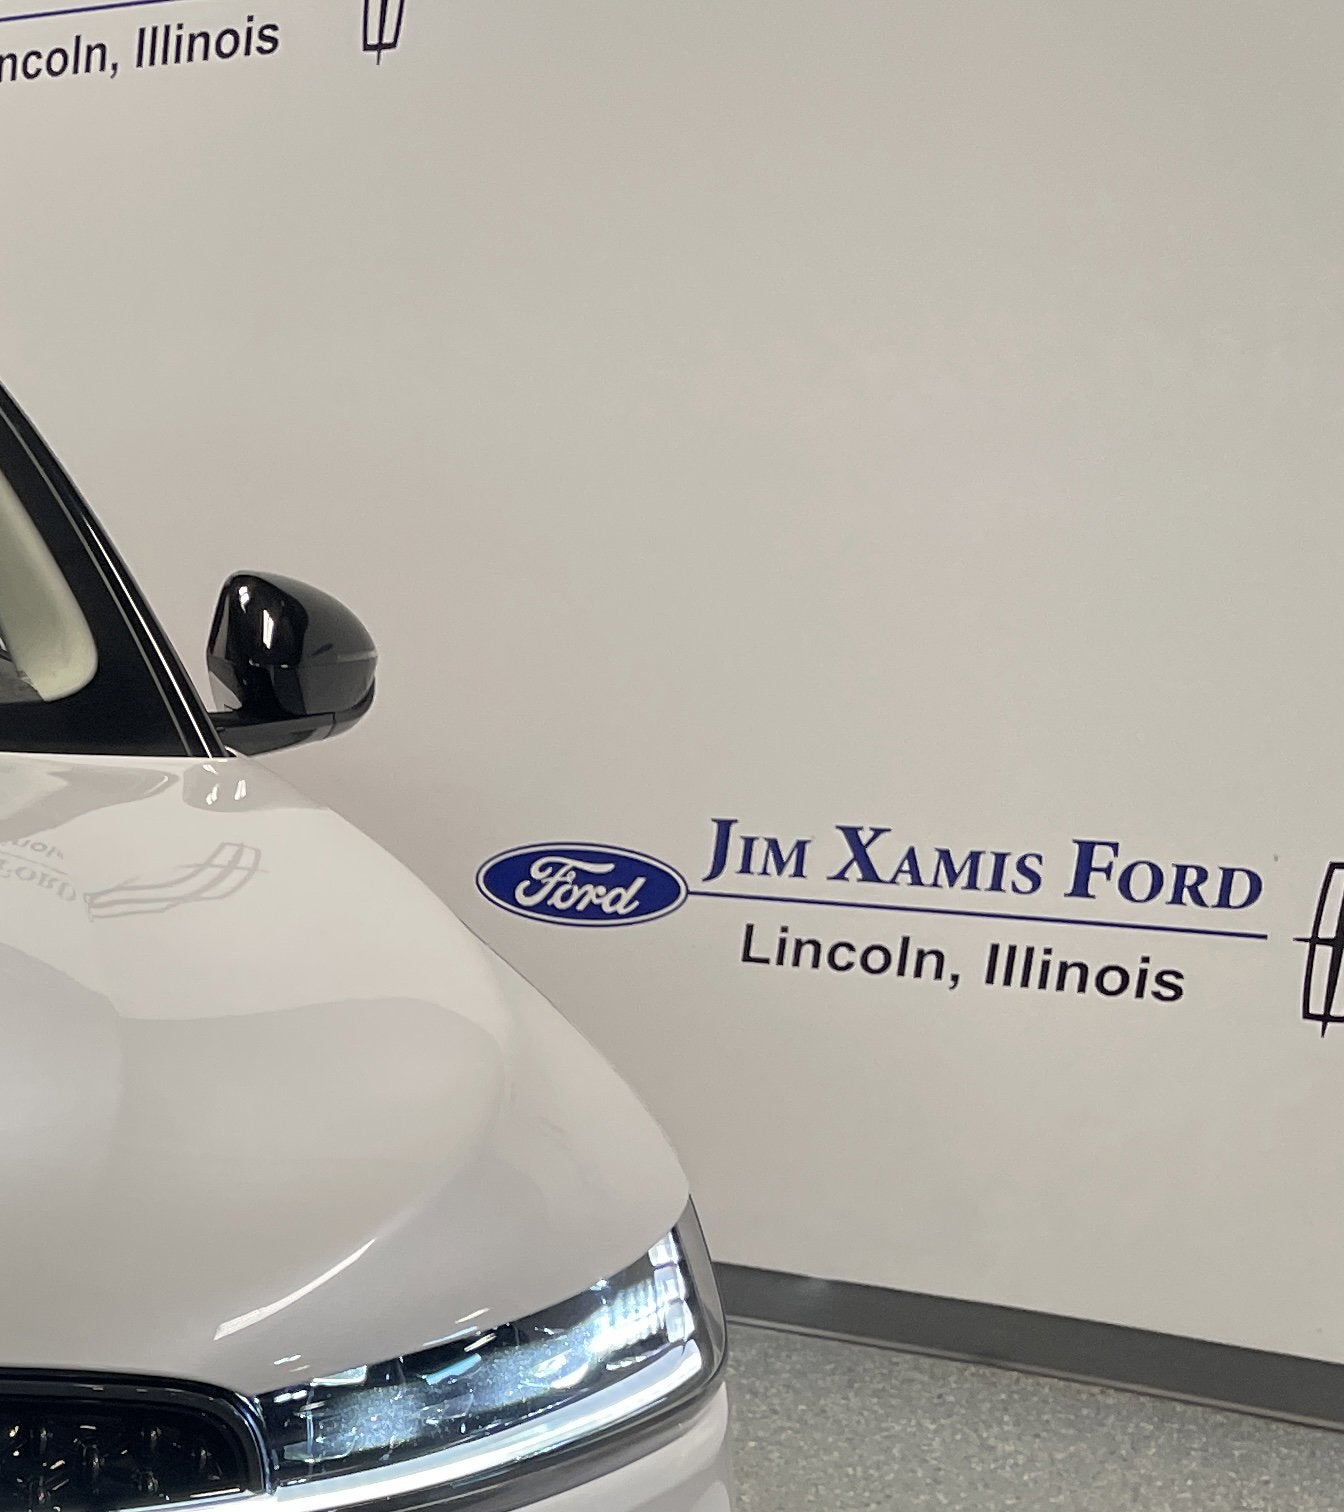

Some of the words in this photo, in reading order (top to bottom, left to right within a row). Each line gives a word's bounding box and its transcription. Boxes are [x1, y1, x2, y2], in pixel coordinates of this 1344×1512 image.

[136, 14, 279, 69] Illinois
[515, 856, 646, 915] Ford
[701, 818, 813, 882] JIM
[826, 825, 1044, 896] XAMIS
[1063, 839, 1263, 910] FORD
[741, 923, 960, 990] Lincoln,
[984, 943, 1185, 1002] Illinois
